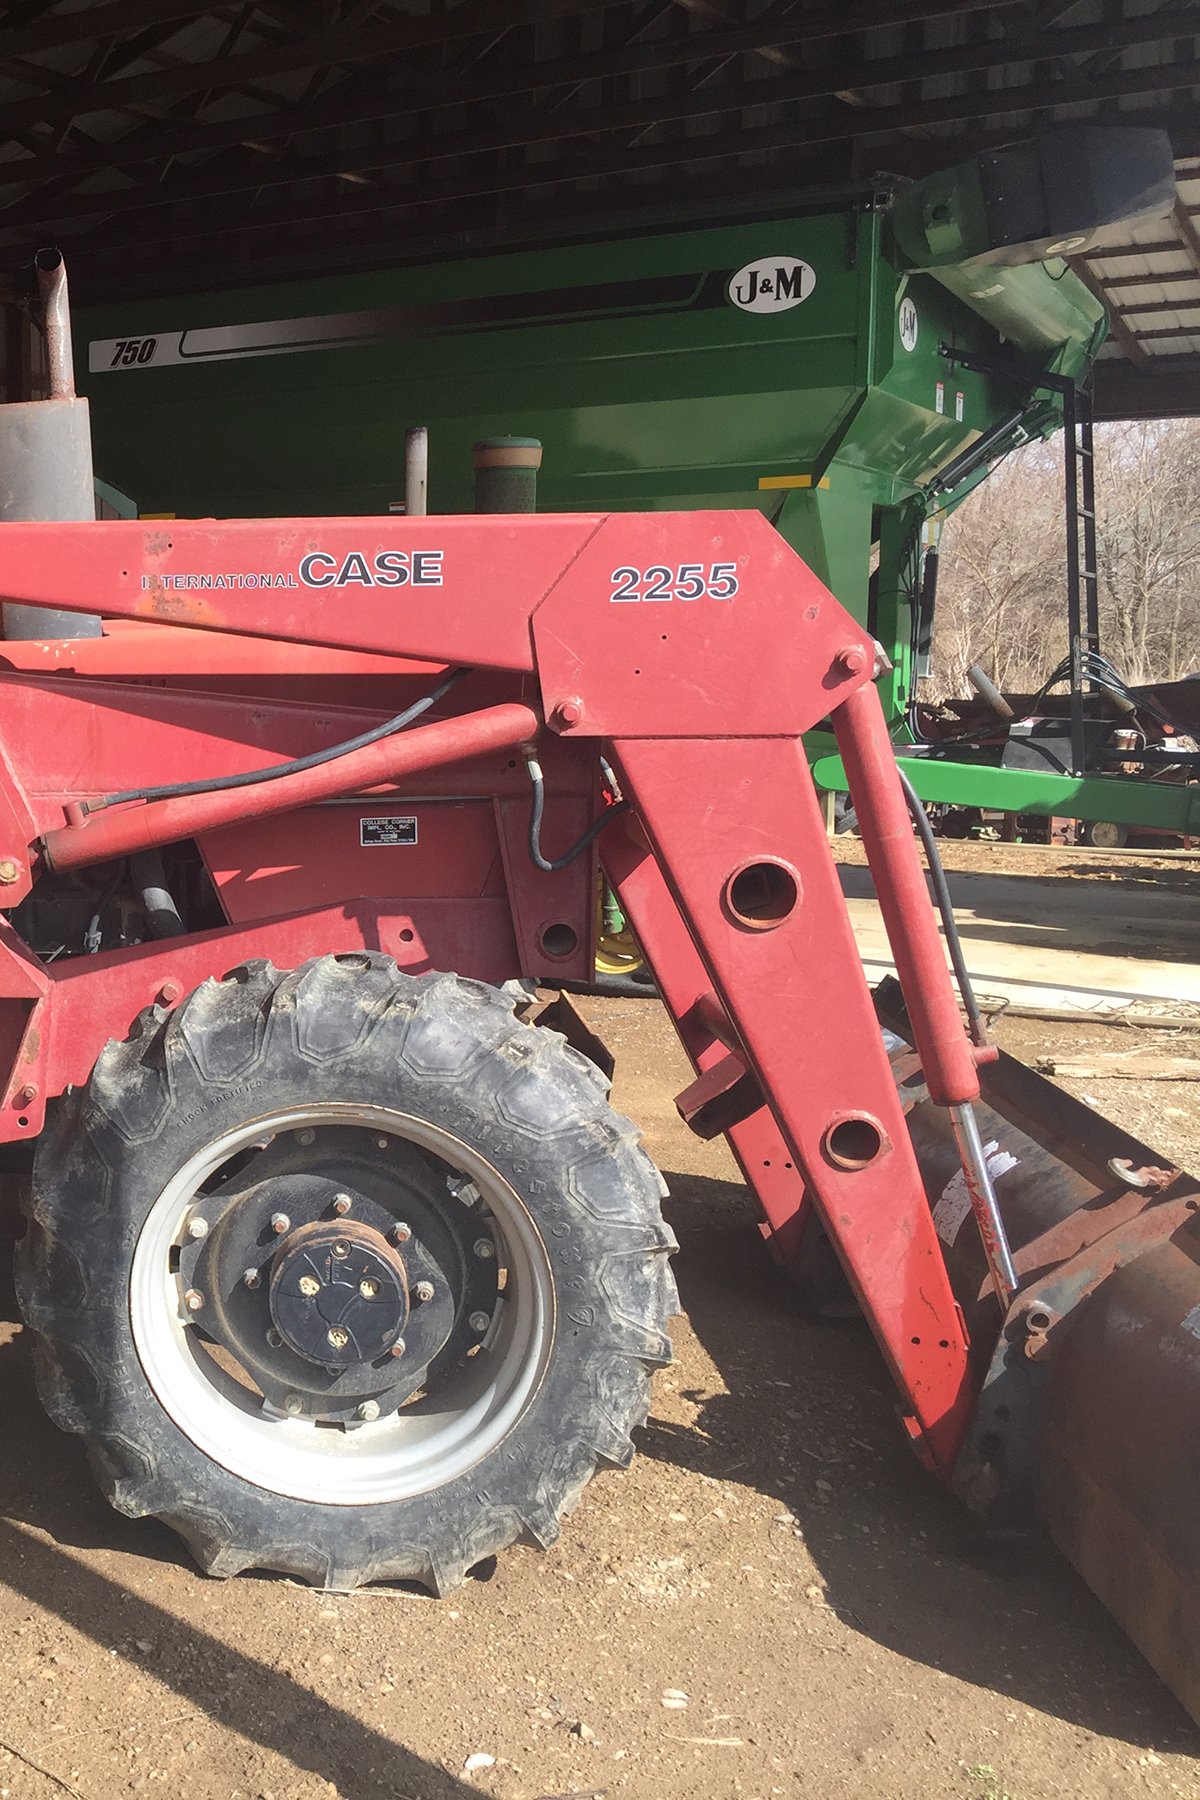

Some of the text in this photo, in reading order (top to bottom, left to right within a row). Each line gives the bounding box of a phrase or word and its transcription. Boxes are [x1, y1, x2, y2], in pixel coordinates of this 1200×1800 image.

[735, 265, 805, 305] J&M
[901, 306, 916, 344] J&M
[109, 338, 157, 368] 750
[299, 550, 444, 589] CASE
[610, 563, 739, 602] 2255
